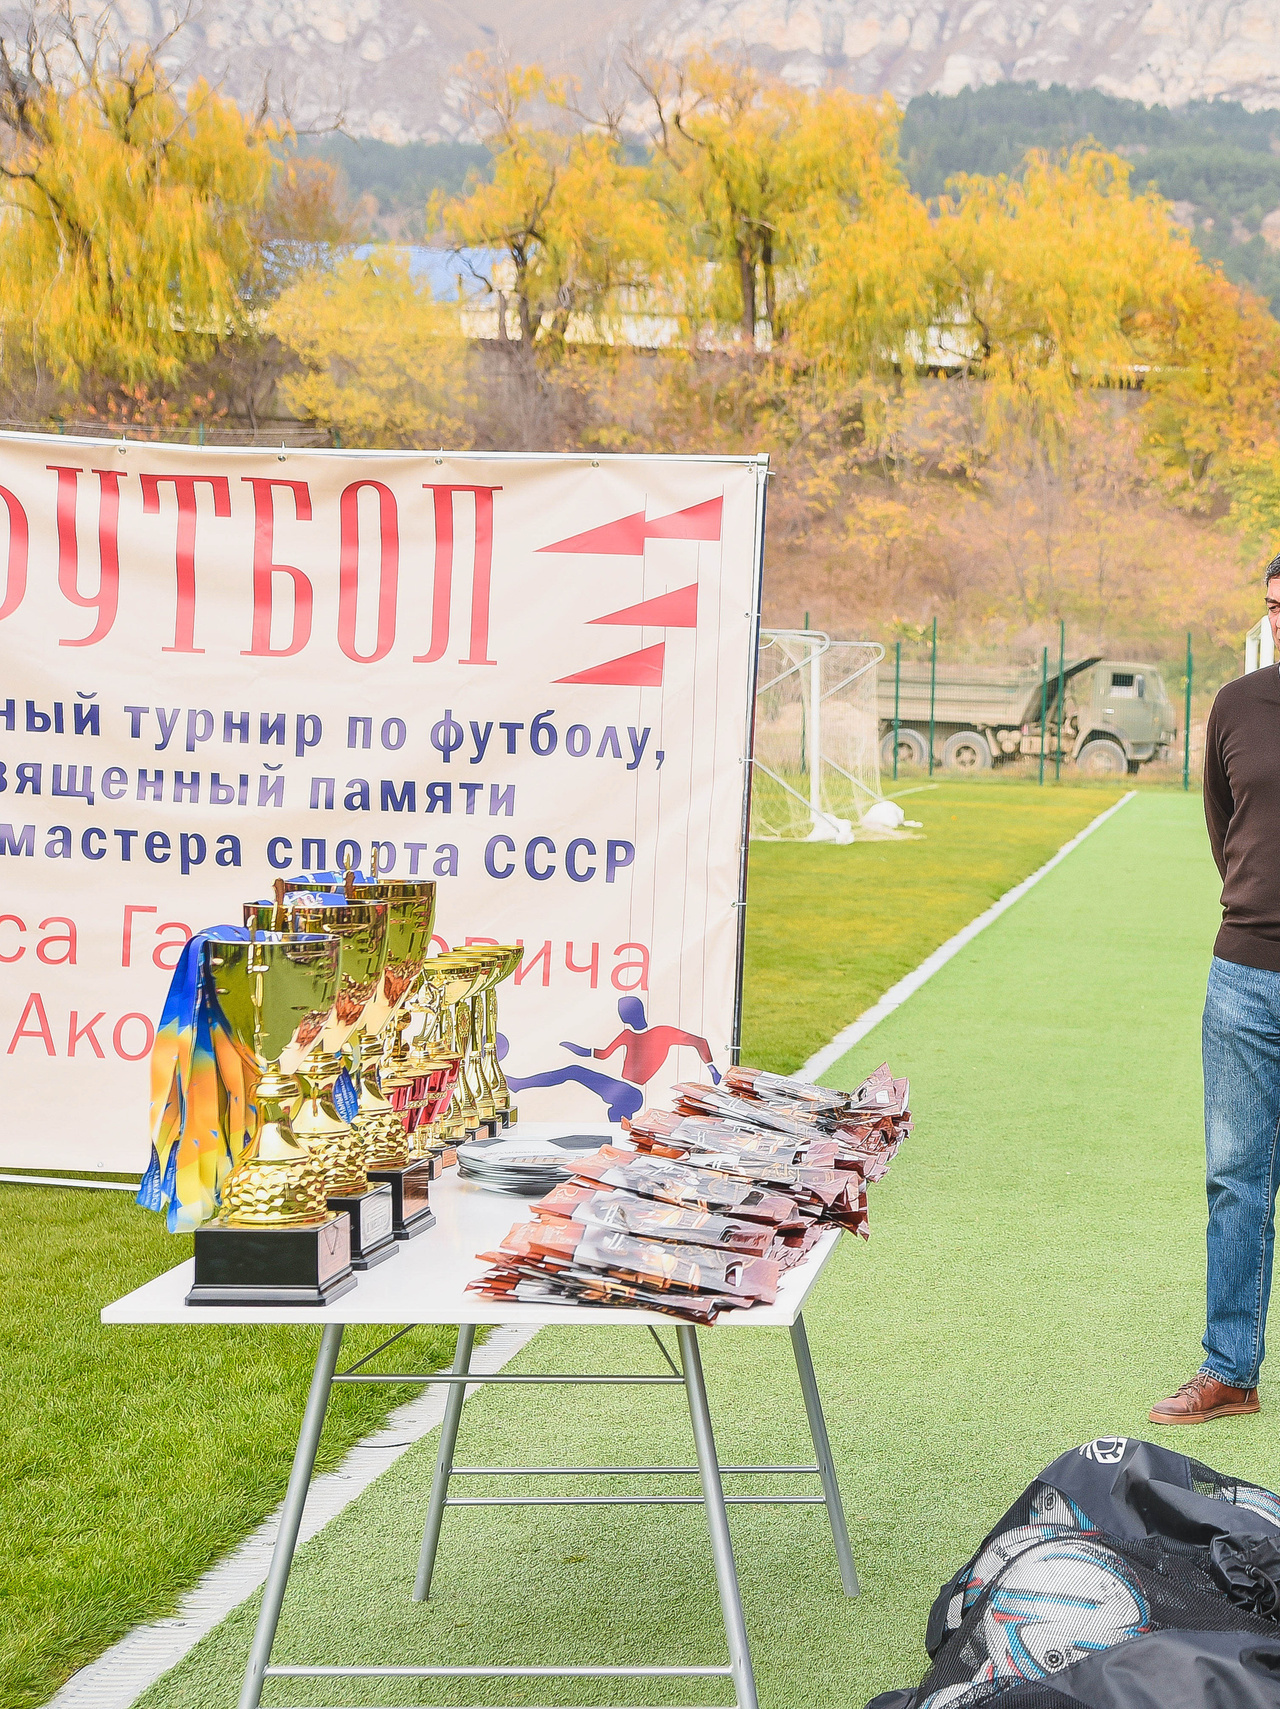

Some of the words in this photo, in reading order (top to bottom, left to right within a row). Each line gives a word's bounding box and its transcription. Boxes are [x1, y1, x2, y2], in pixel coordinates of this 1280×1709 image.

[123, 705, 323, 757] турнир
[347, 716, 407, 751] по
[430, 709, 665, 770] футболу,
[0, 761, 285, 808] ященный
[309, 777, 516, 816] памяти
[0, 823, 242, 875] мастера
[266, 836, 458, 876] спорта
[484, 834, 636, 884] СССР
